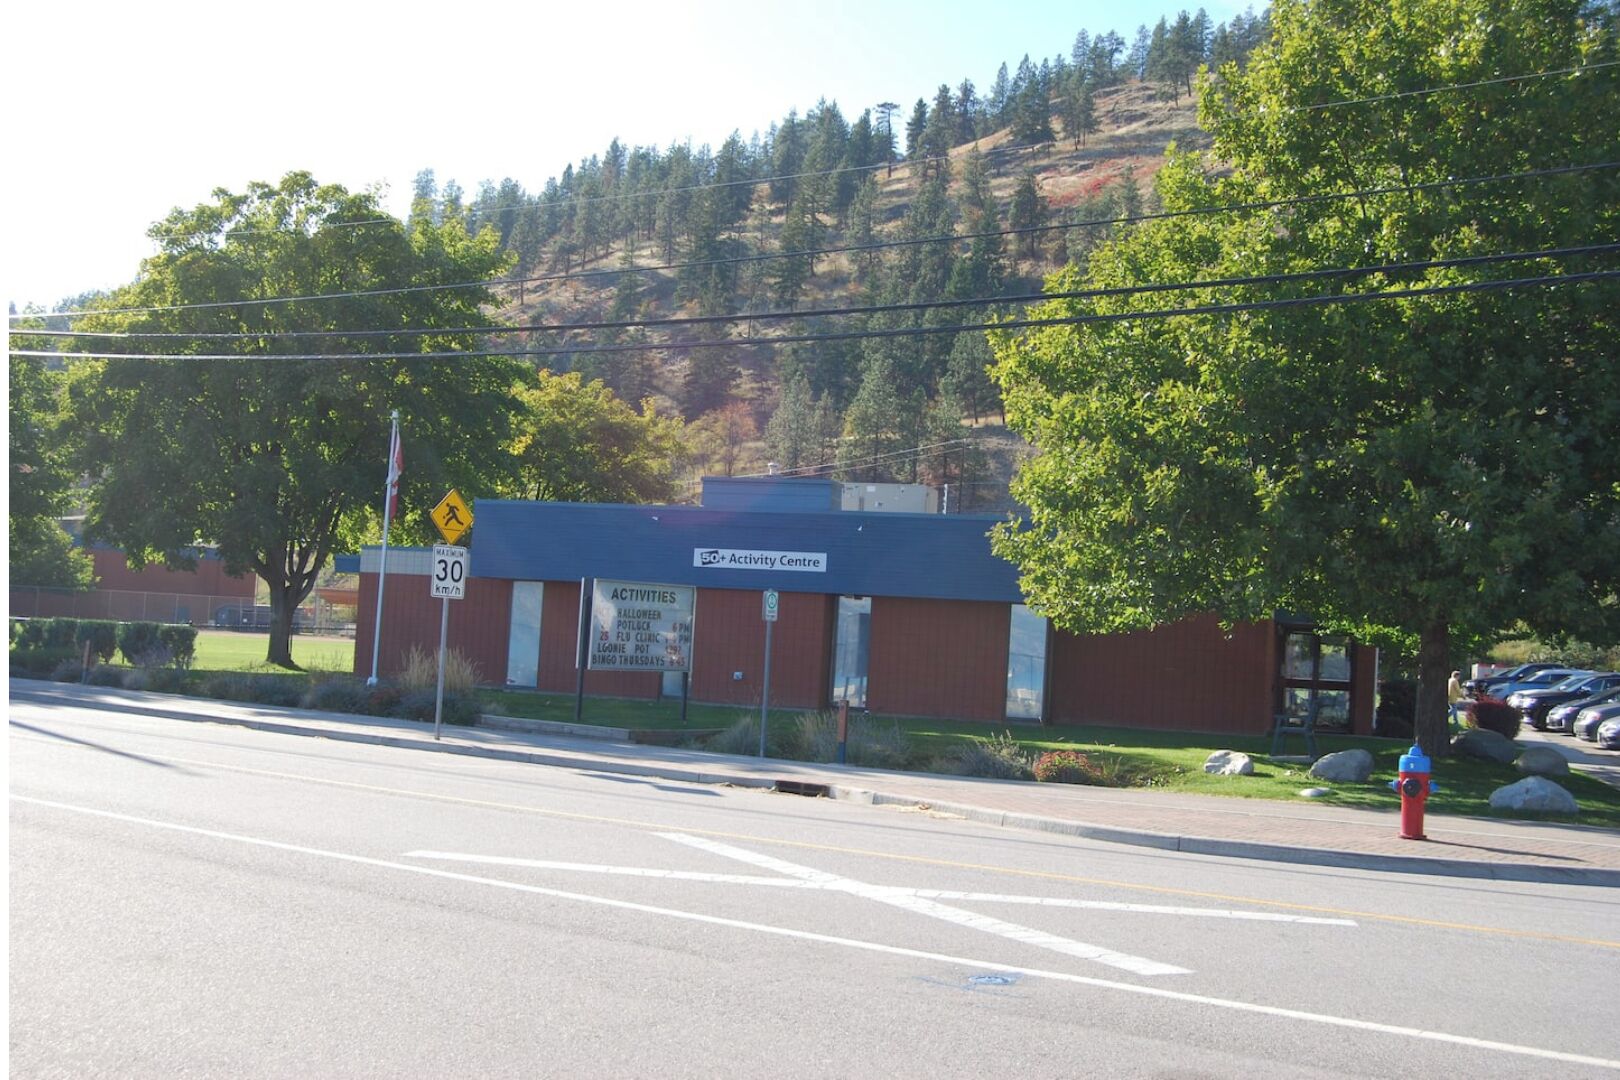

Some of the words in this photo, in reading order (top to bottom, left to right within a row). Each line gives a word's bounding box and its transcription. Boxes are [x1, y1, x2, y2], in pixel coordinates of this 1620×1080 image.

[700, 550, 726, 566] 50+
[729, 553, 777, 568] Activity
[780, 555, 820, 568] Centre
[436, 559, 463, 583] 30
[435, 584, 461, 595] km/h
[611, 588, 677, 604] ACTIVITIES
[617, 608, 661, 620] HALLOWEEN
[617, 620, 651, 631] POTLUCK
[617, 631, 630, 642] FLU
[635, 632, 660, 643] CLINIC
[635, 644, 649, 654] POT
[592, 654, 617, 665] BINGO
[619, 655, 665, 666] THURSDAYS
